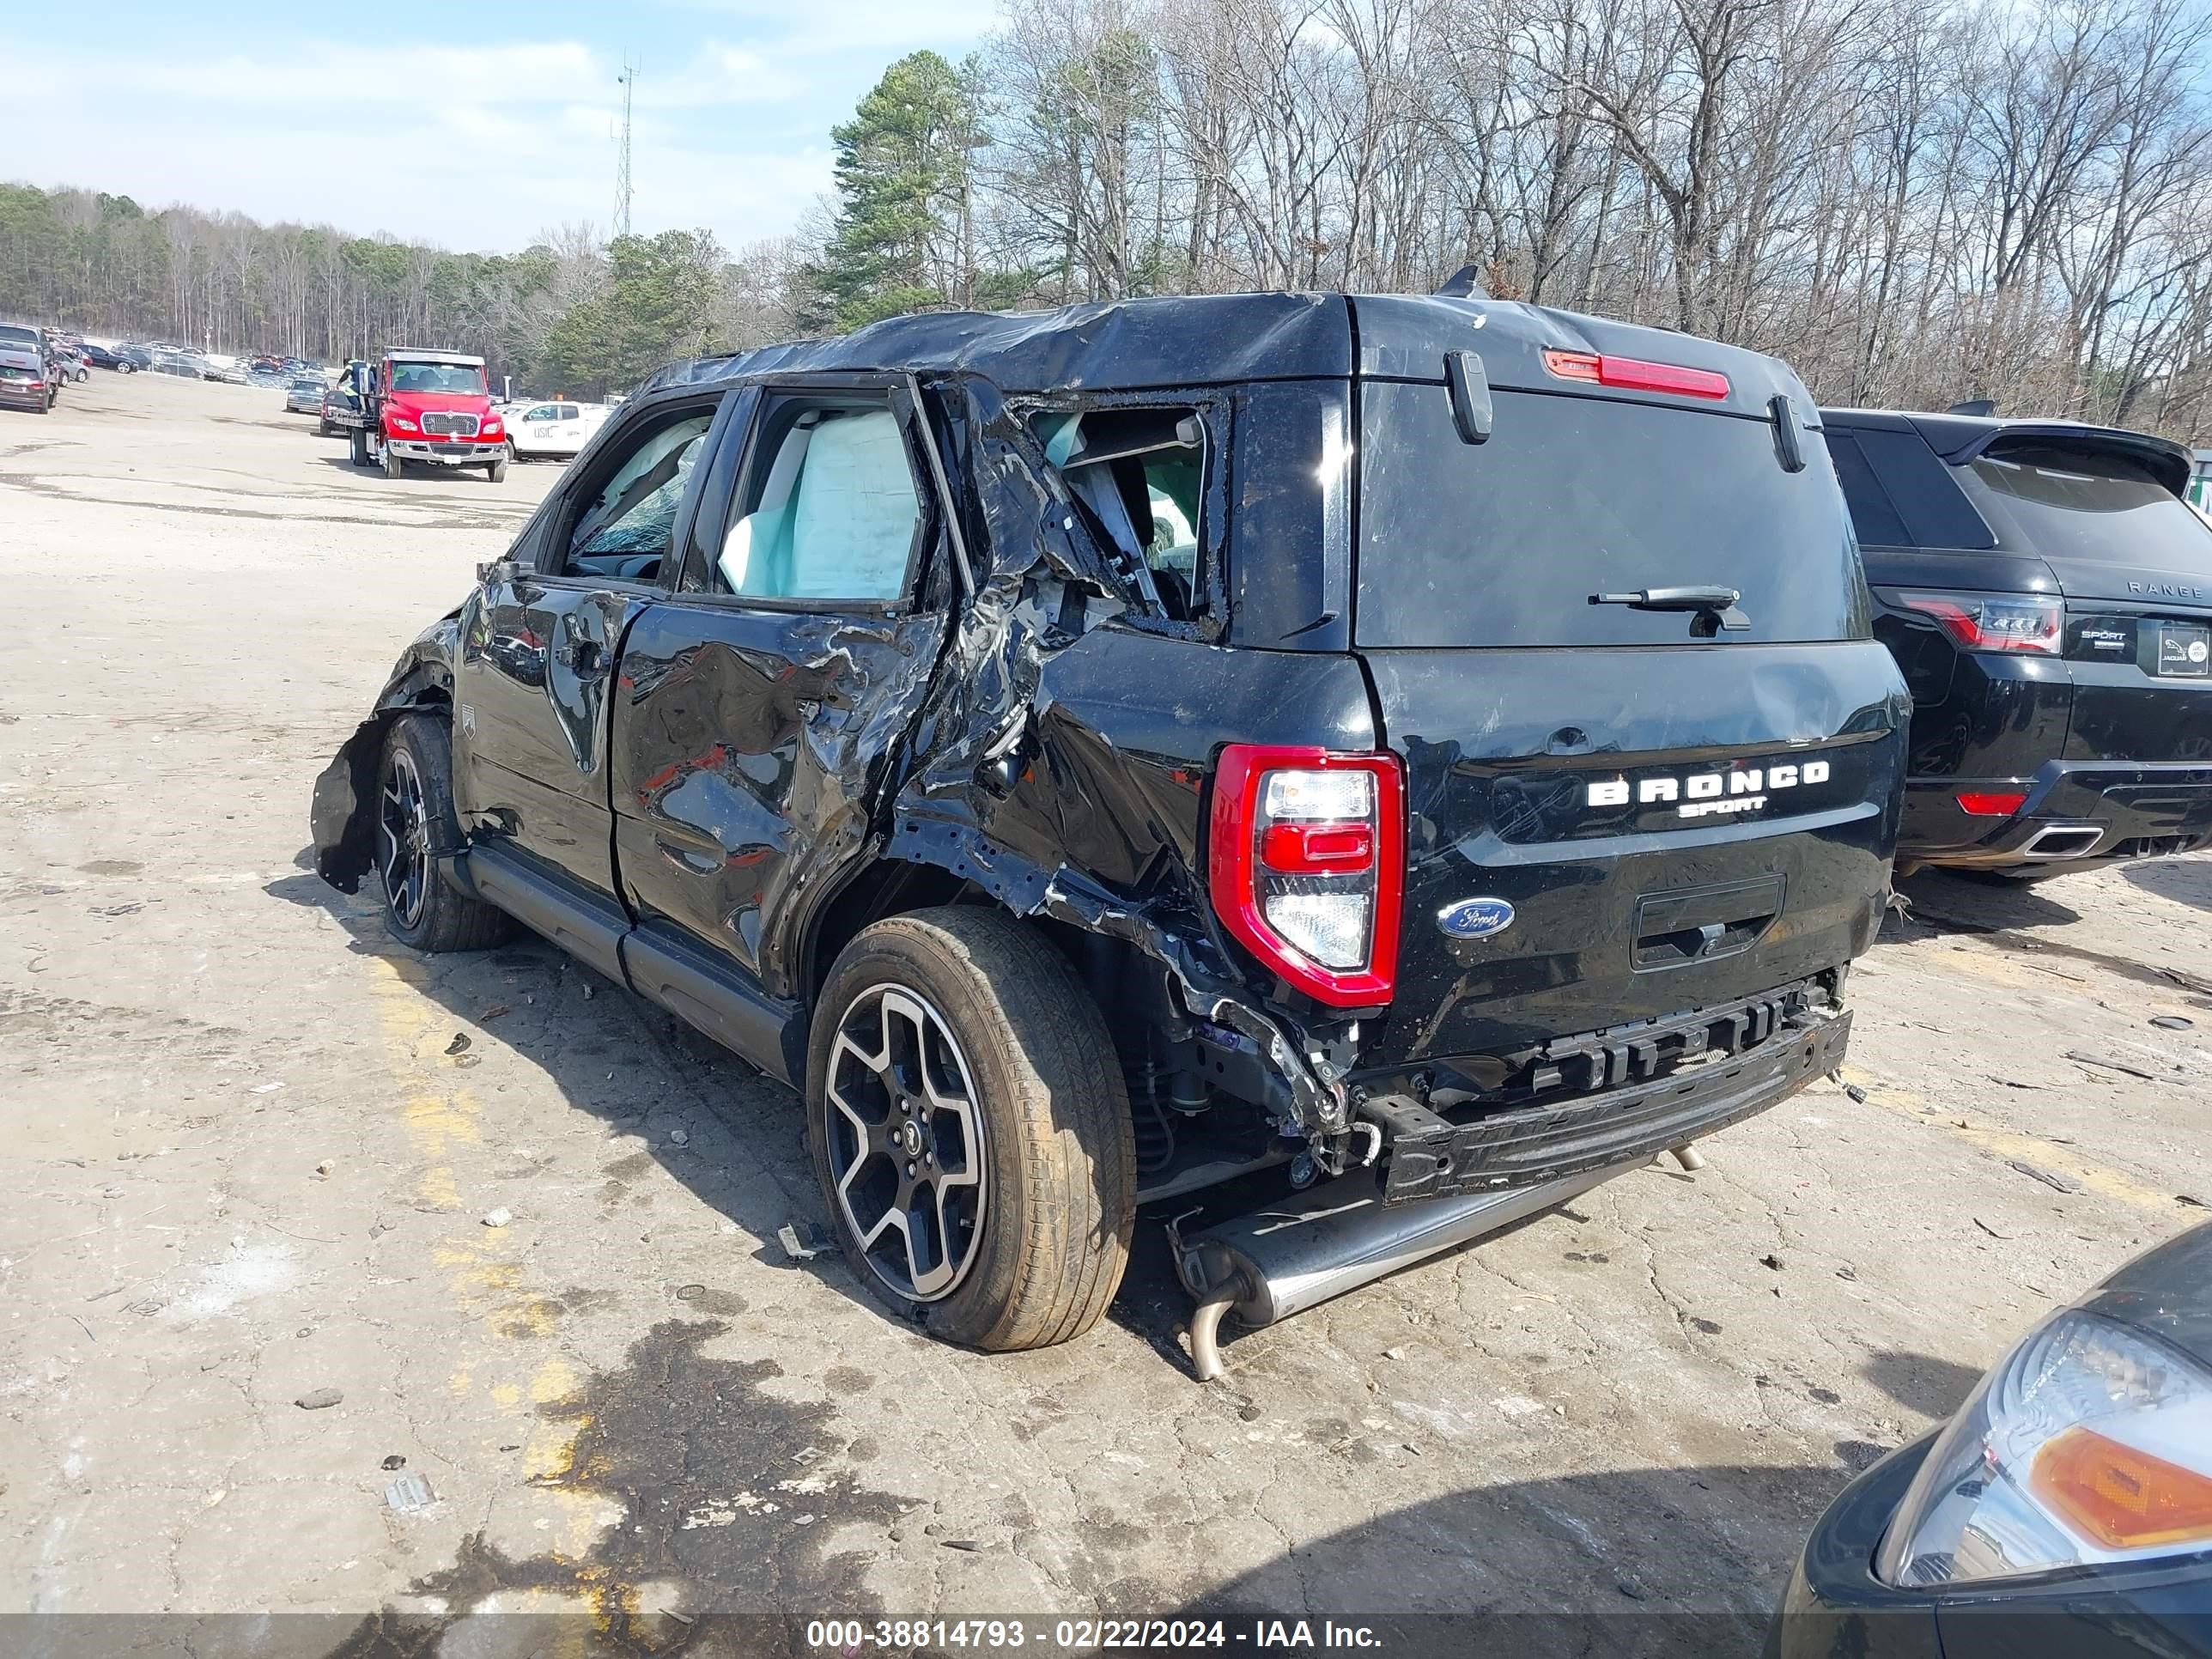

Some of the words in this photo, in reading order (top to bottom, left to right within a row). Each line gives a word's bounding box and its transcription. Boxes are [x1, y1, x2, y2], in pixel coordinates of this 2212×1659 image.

[2127, 581, 2203, 599] RANGE
[2081, 630, 2126, 641] SPORT
[1588, 761, 1829, 806] BRONCO
[1678, 796, 1768, 817] SPORT
[1457, 907, 1500, 929] Ford
